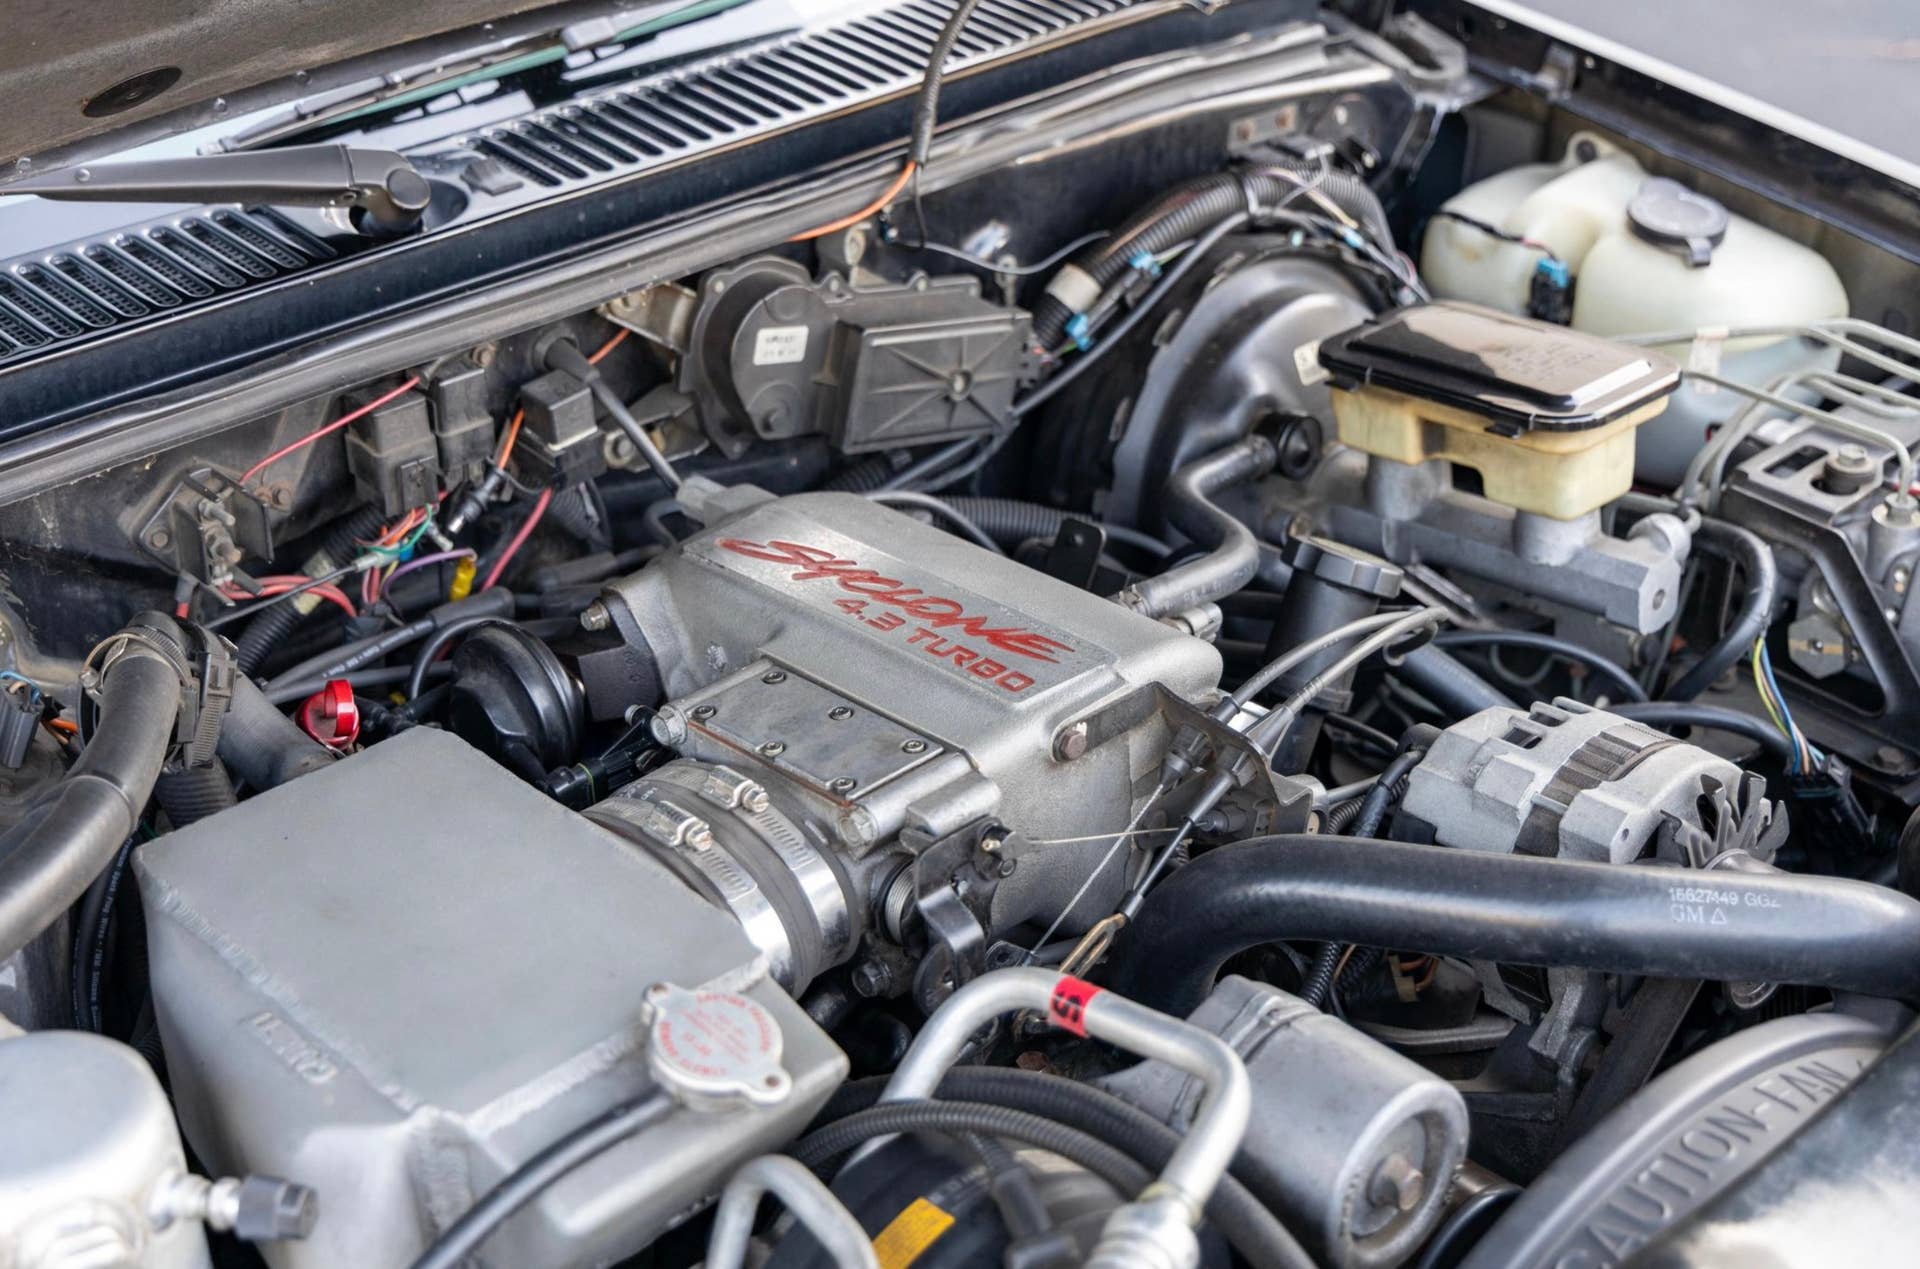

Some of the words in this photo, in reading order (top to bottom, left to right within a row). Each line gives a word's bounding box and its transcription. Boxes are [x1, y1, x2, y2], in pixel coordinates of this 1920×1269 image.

[714, 538, 1075, 664] SYCLONE
[833, 598, 907, 632] 4.3
[907, 626, 1035, 693] TURBO
[1669, 903, 1706, 924] GM
